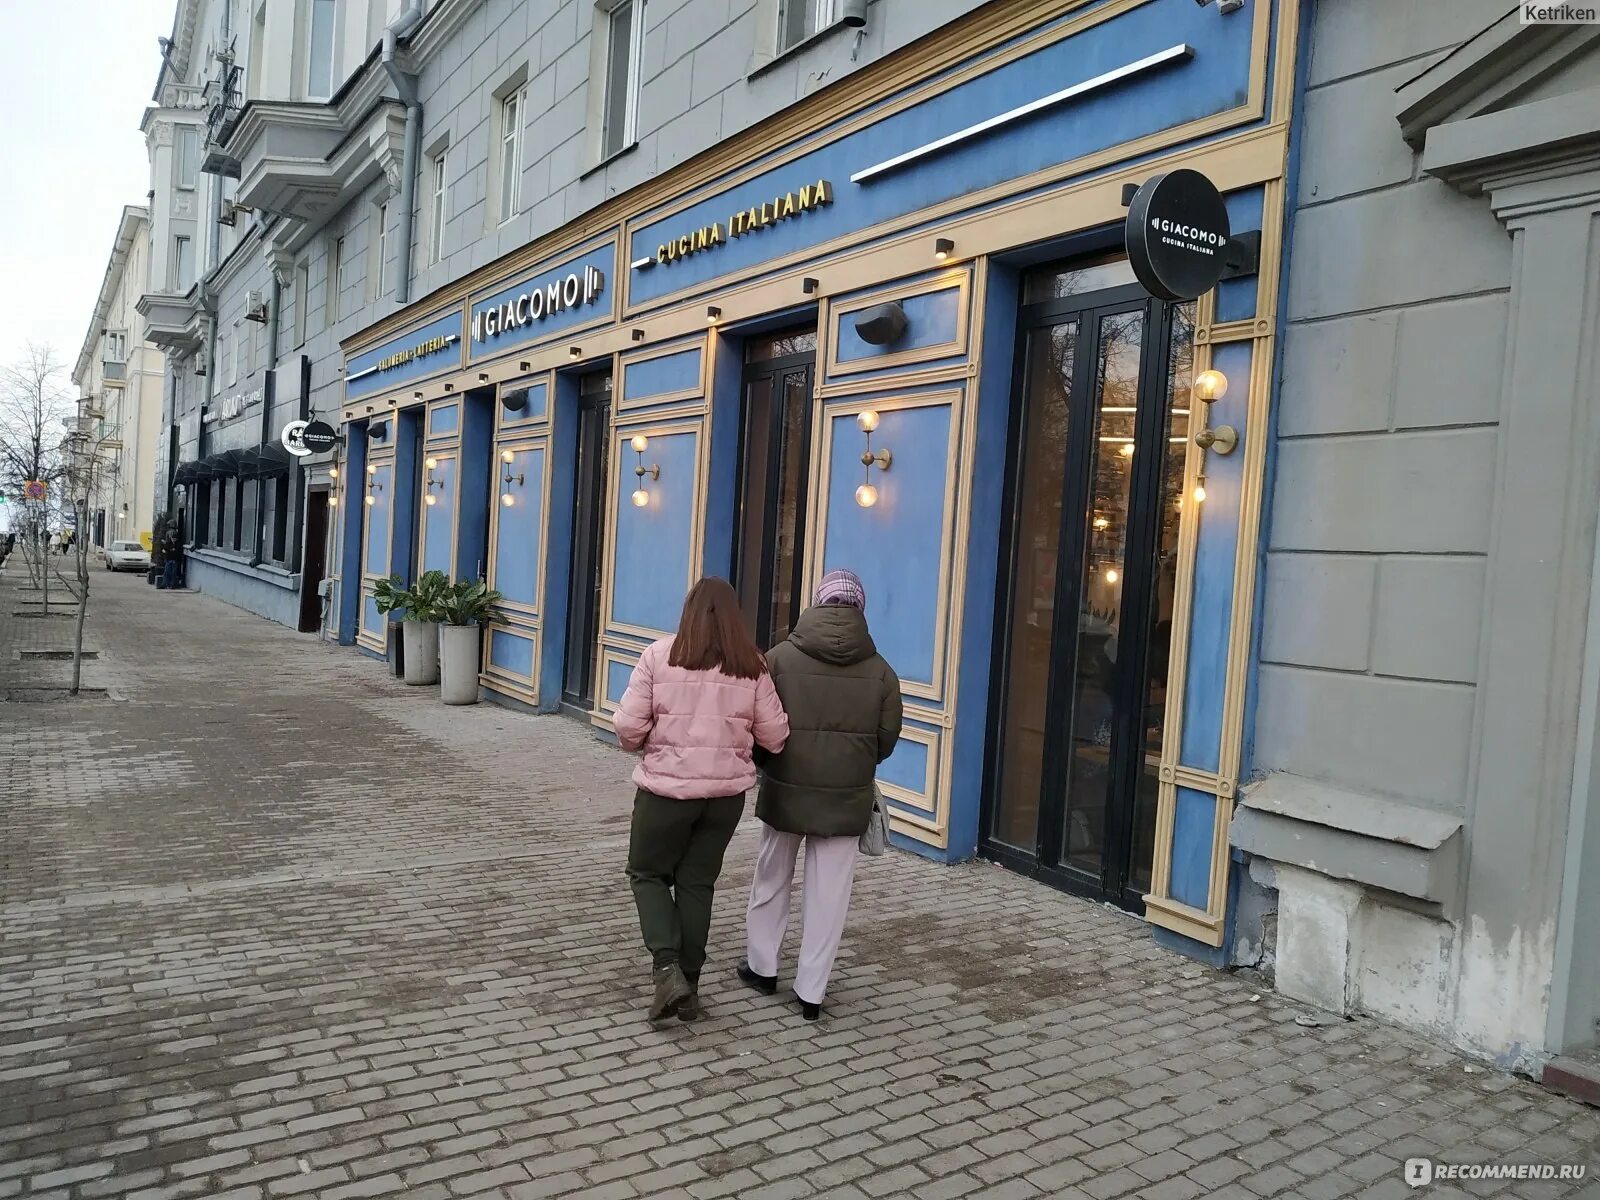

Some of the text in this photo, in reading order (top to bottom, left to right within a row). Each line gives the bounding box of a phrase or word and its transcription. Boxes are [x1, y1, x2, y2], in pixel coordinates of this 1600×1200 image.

[657, 178, 829, 264] CUCINA ITALIANA
[1161, 219, 1217, 244] GIACOMO
[1162, 236, 1214, 256] CUCINA ITALIANA
[485, 273, 580, 336] GIACOMO
